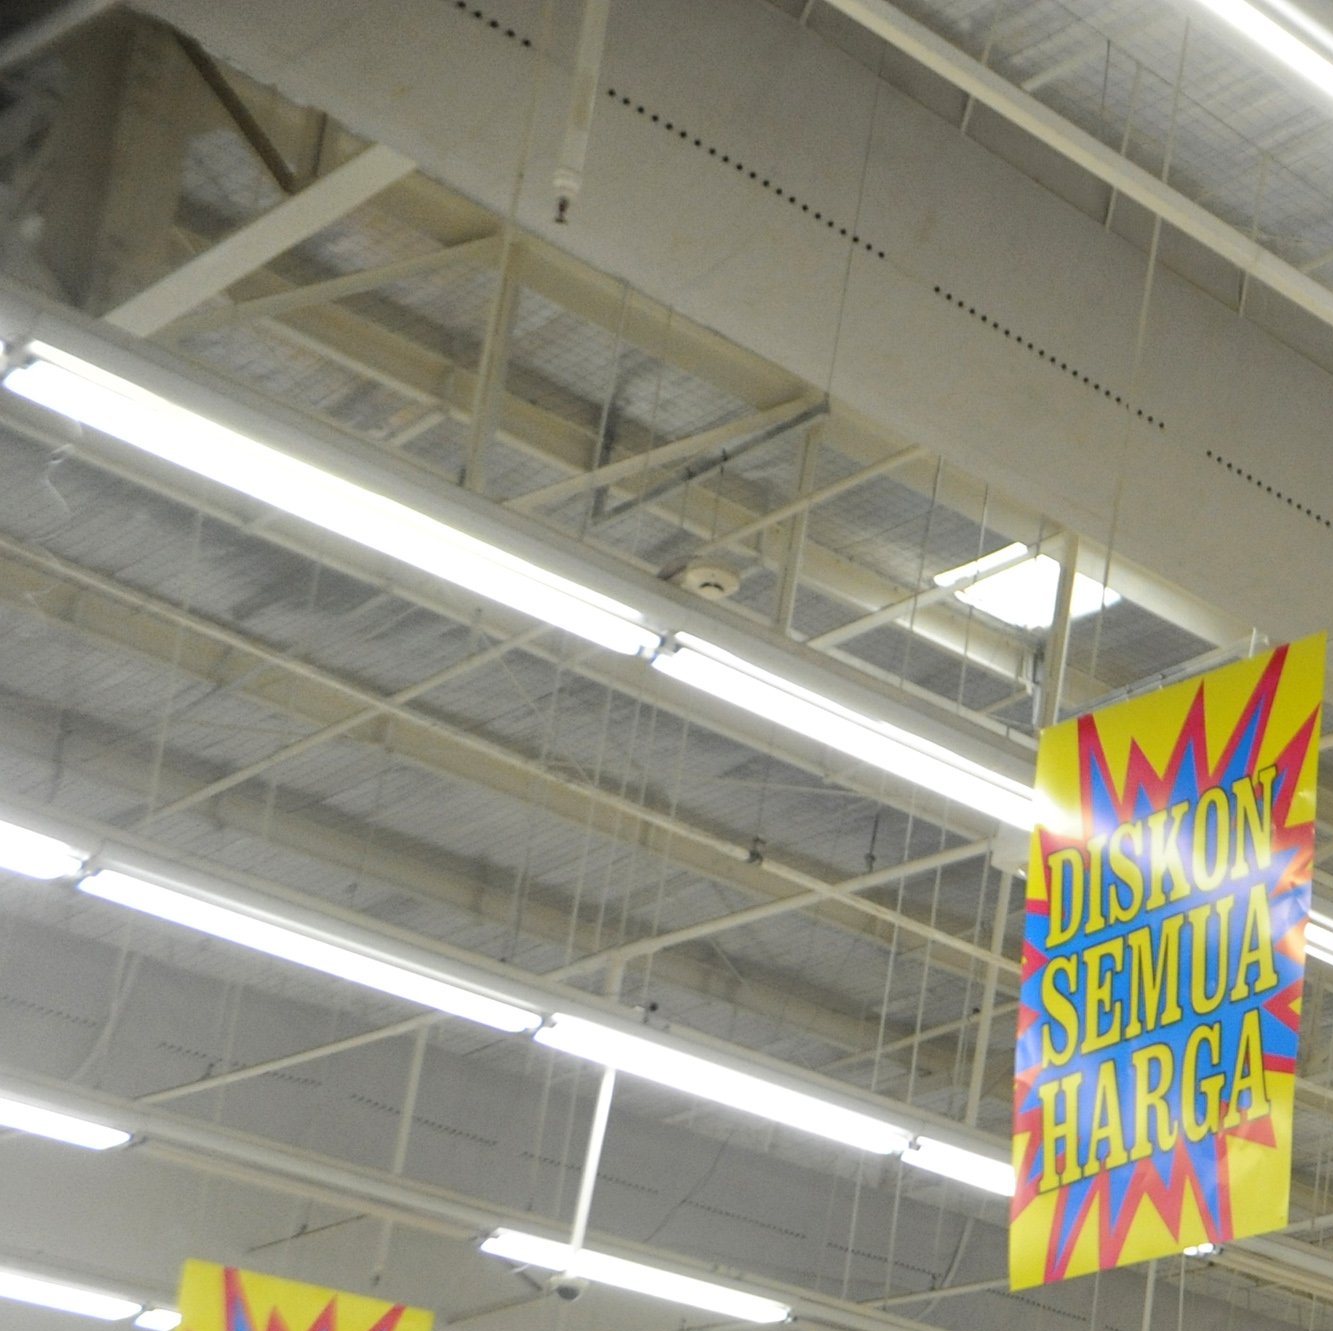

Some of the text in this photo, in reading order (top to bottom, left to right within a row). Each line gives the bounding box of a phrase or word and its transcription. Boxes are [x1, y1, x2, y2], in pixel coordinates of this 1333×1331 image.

[1045, 764, 1277, 949] DISKON
[1040, 882, 1278, 1069] SEMUA
[1037, 1009, 1271, 1195] HARGA
